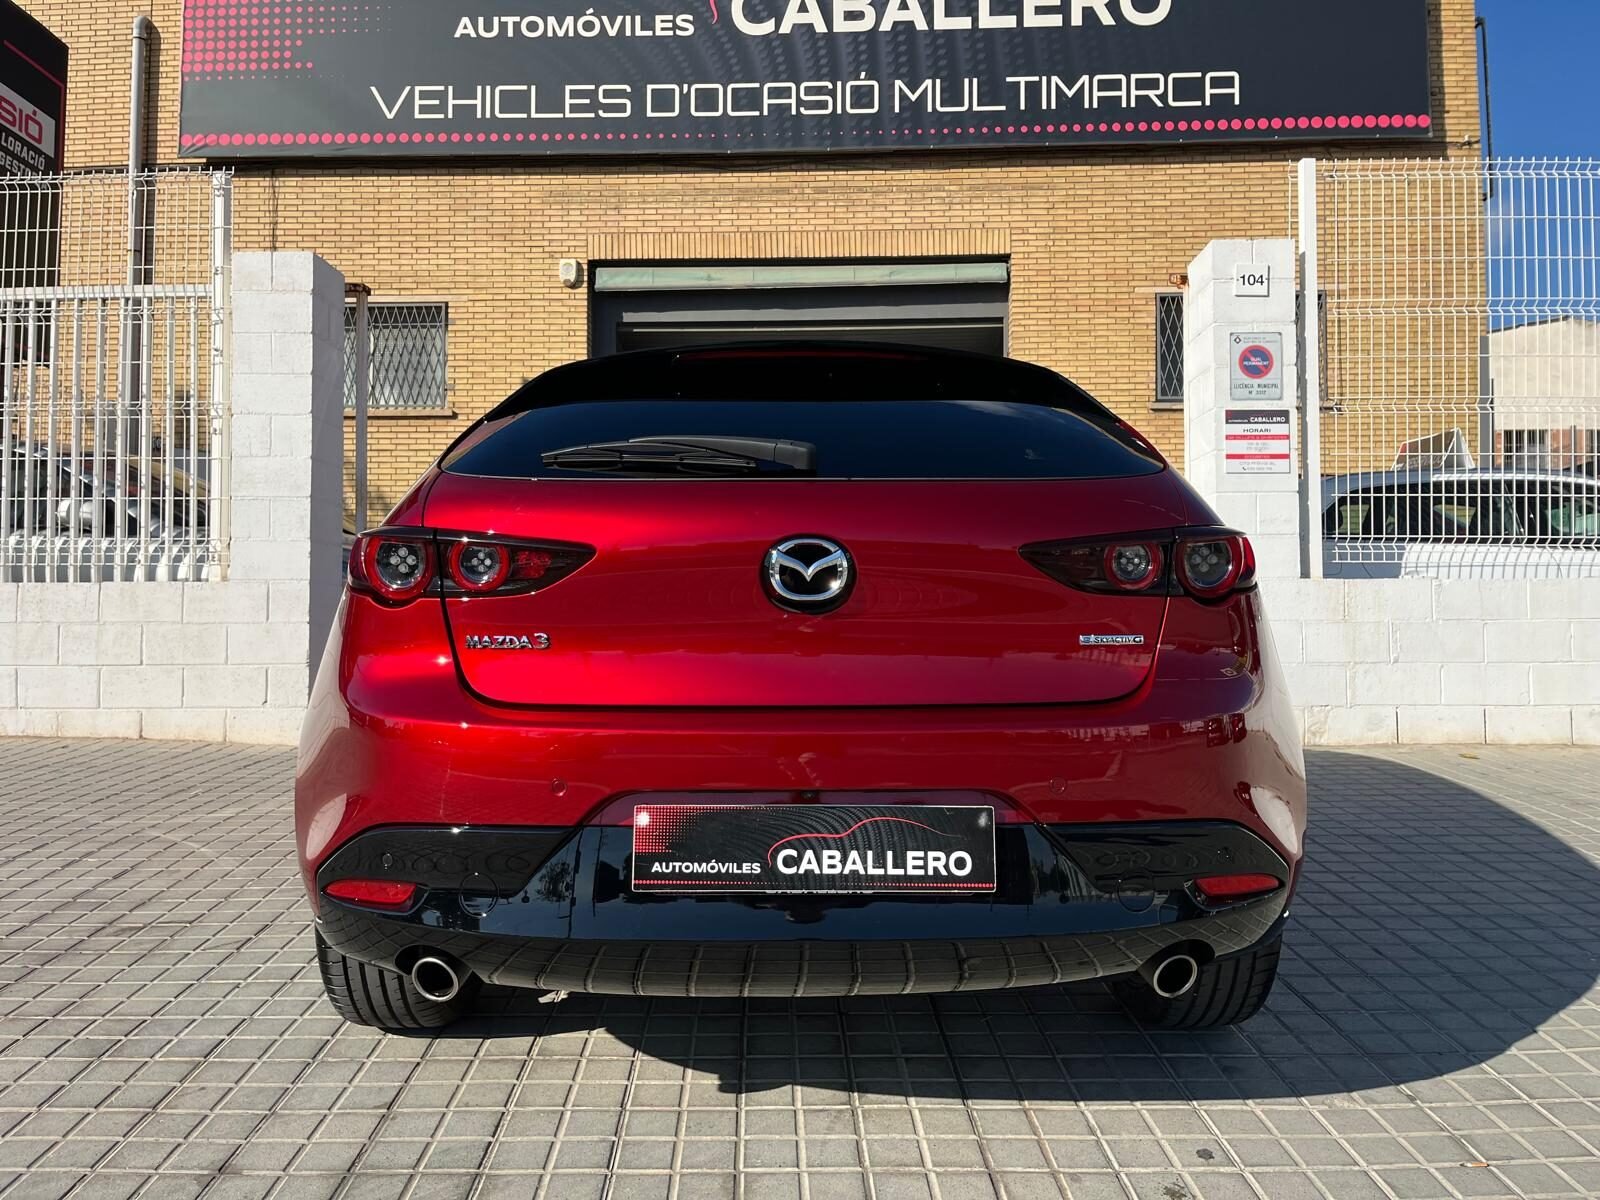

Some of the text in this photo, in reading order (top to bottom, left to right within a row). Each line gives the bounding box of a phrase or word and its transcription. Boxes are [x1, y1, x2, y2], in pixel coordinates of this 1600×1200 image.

[453, 8, 695, 39] AUTOMÓVILES
[369, 71, 1240, 120] VEHICLES D'OCASIÓ MULTIMARCA
[1239, 273, 1265, 286] 104
[651, 849, 973, 876] AUTOMÓVILES CABALLERO
